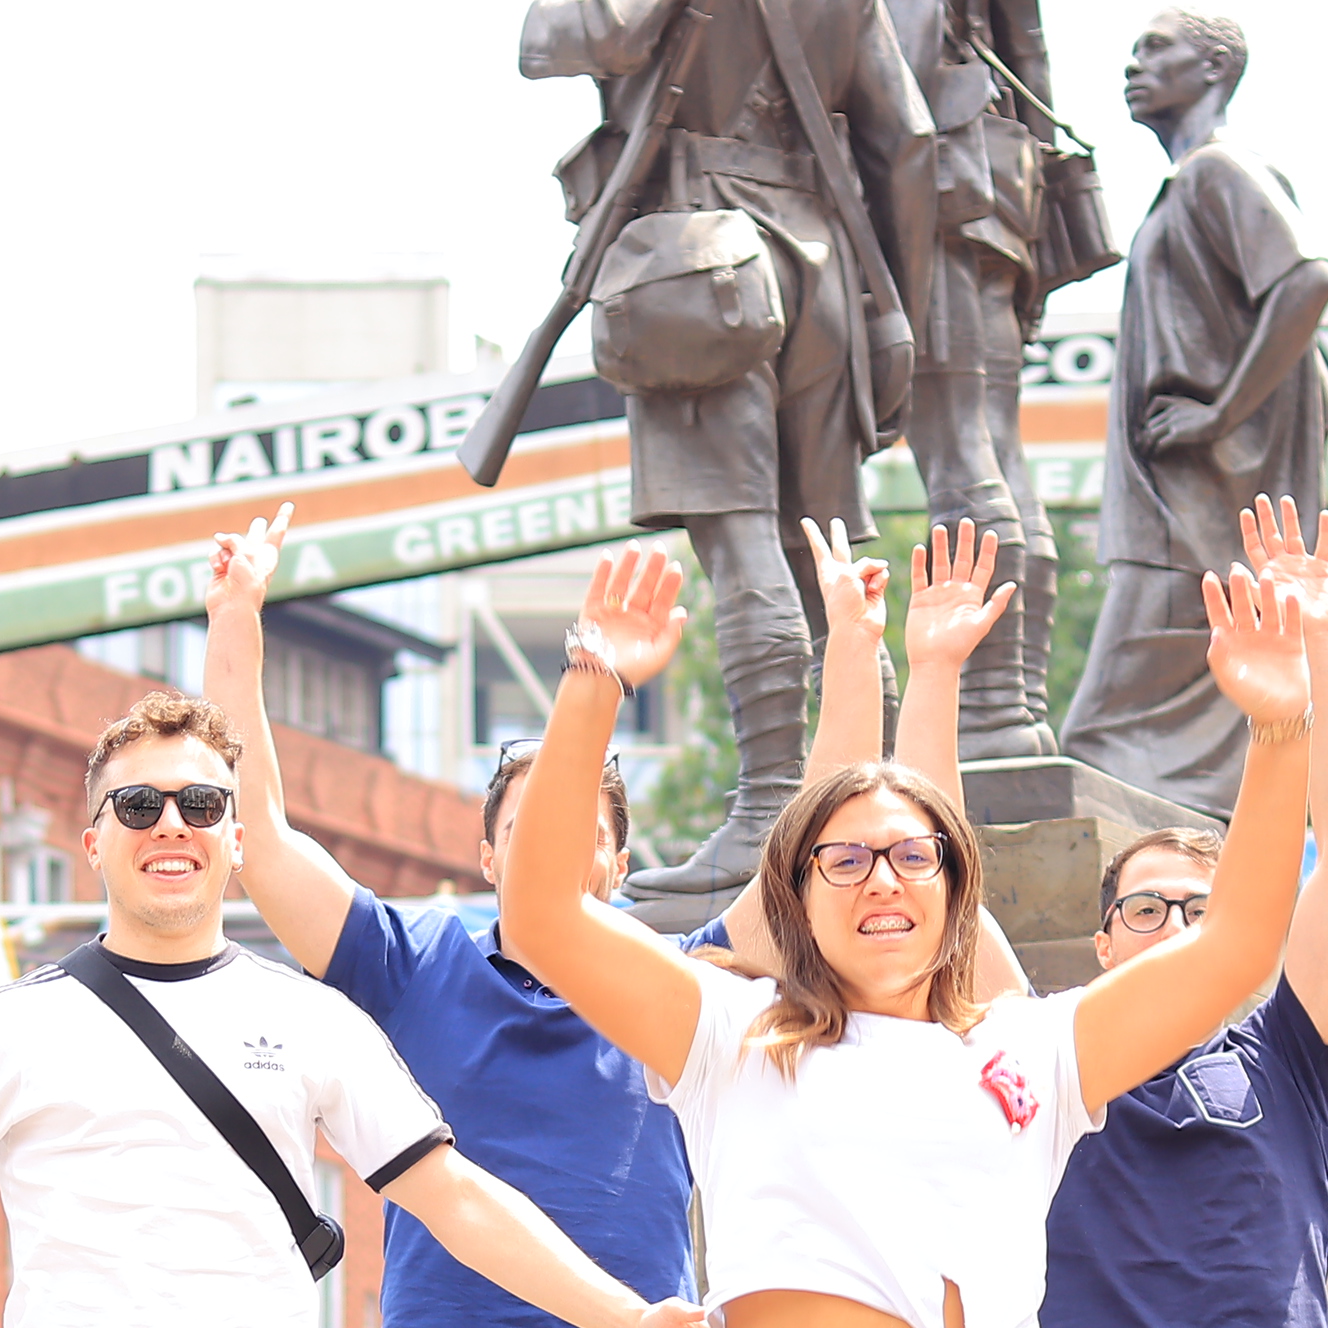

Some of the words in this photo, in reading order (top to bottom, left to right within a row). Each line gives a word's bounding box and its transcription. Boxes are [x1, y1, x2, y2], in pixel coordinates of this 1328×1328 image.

[150, 396, 487, 493] NAIROB
[294, 544, 335, 586] A
[394, 486, 630, 564] GREENE
[244, 1060, 285, 1072] adidas
